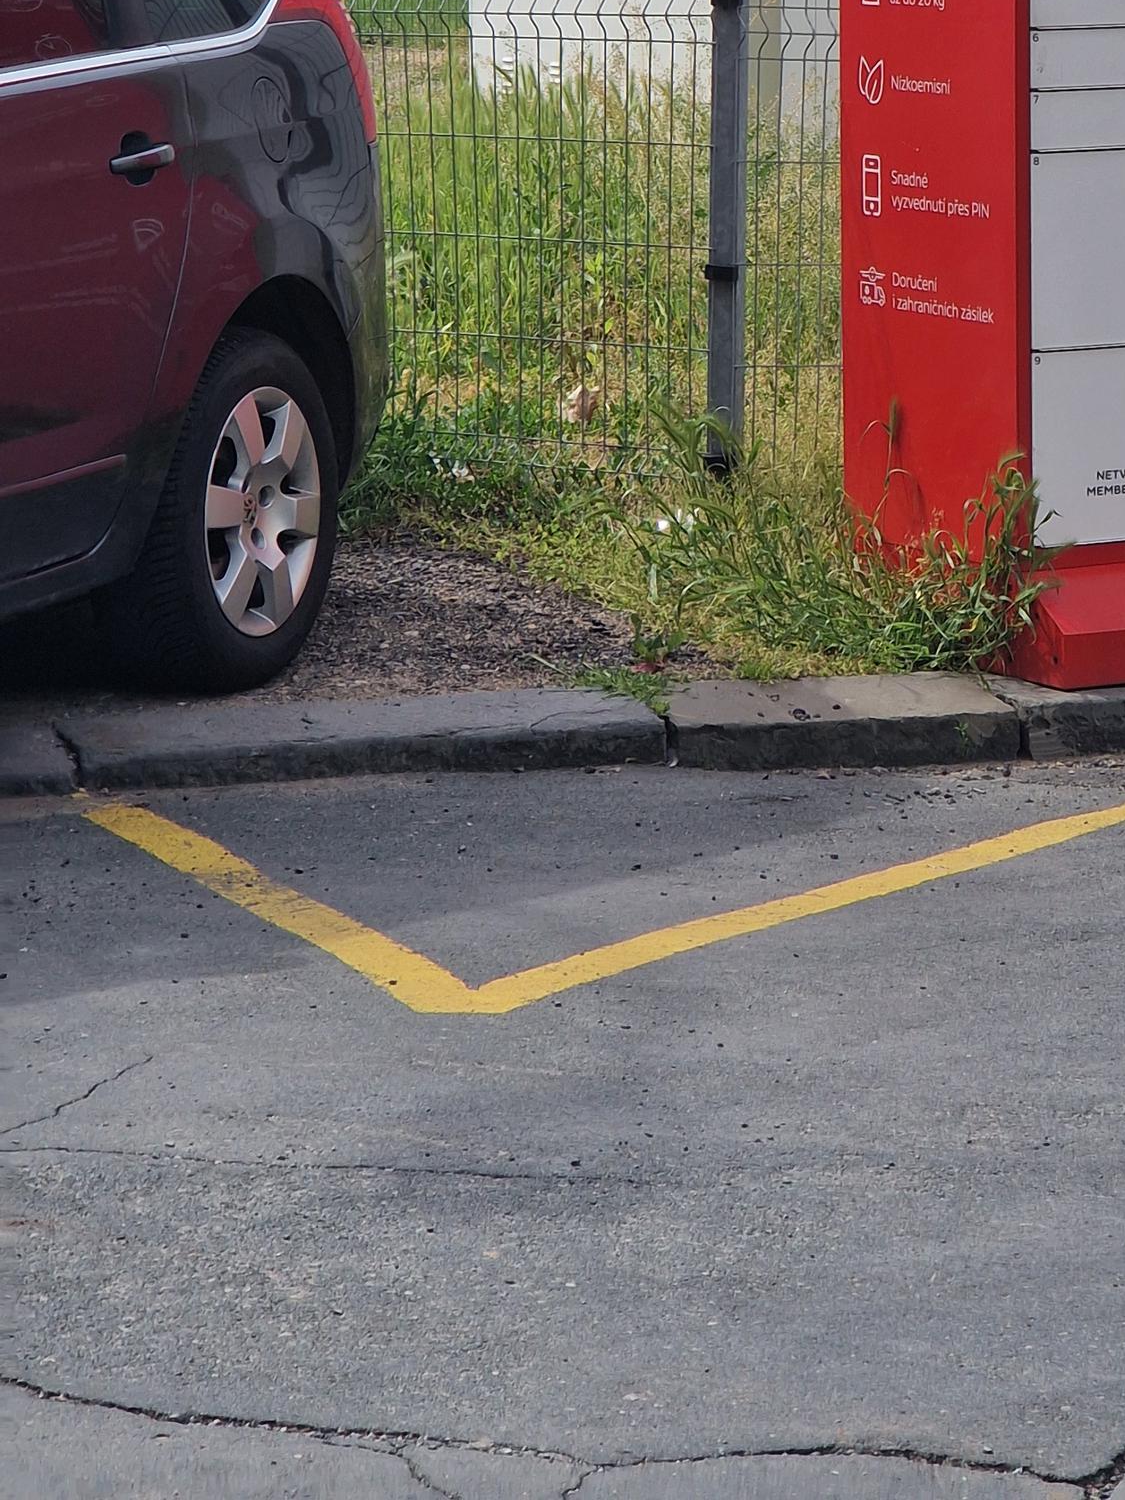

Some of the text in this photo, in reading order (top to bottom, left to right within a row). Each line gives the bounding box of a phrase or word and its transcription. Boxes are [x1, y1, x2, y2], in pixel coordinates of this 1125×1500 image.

[1032, 33, 1039, 42] 6
[890, 74, 951, 95] Nízkoemisní
[1033, 95, 1039, 104] 7
[1033, 157, 1040, 166] 8
[891, 170, 929, 188] Snadné
[891, 195, 990, 219] vyzvednutí přes PIN
[892, 271, 937, 292] Doručení
[892, 293, 995, 324] i zahraničních zásilek
[1034, 356, 1041, 365] 9
